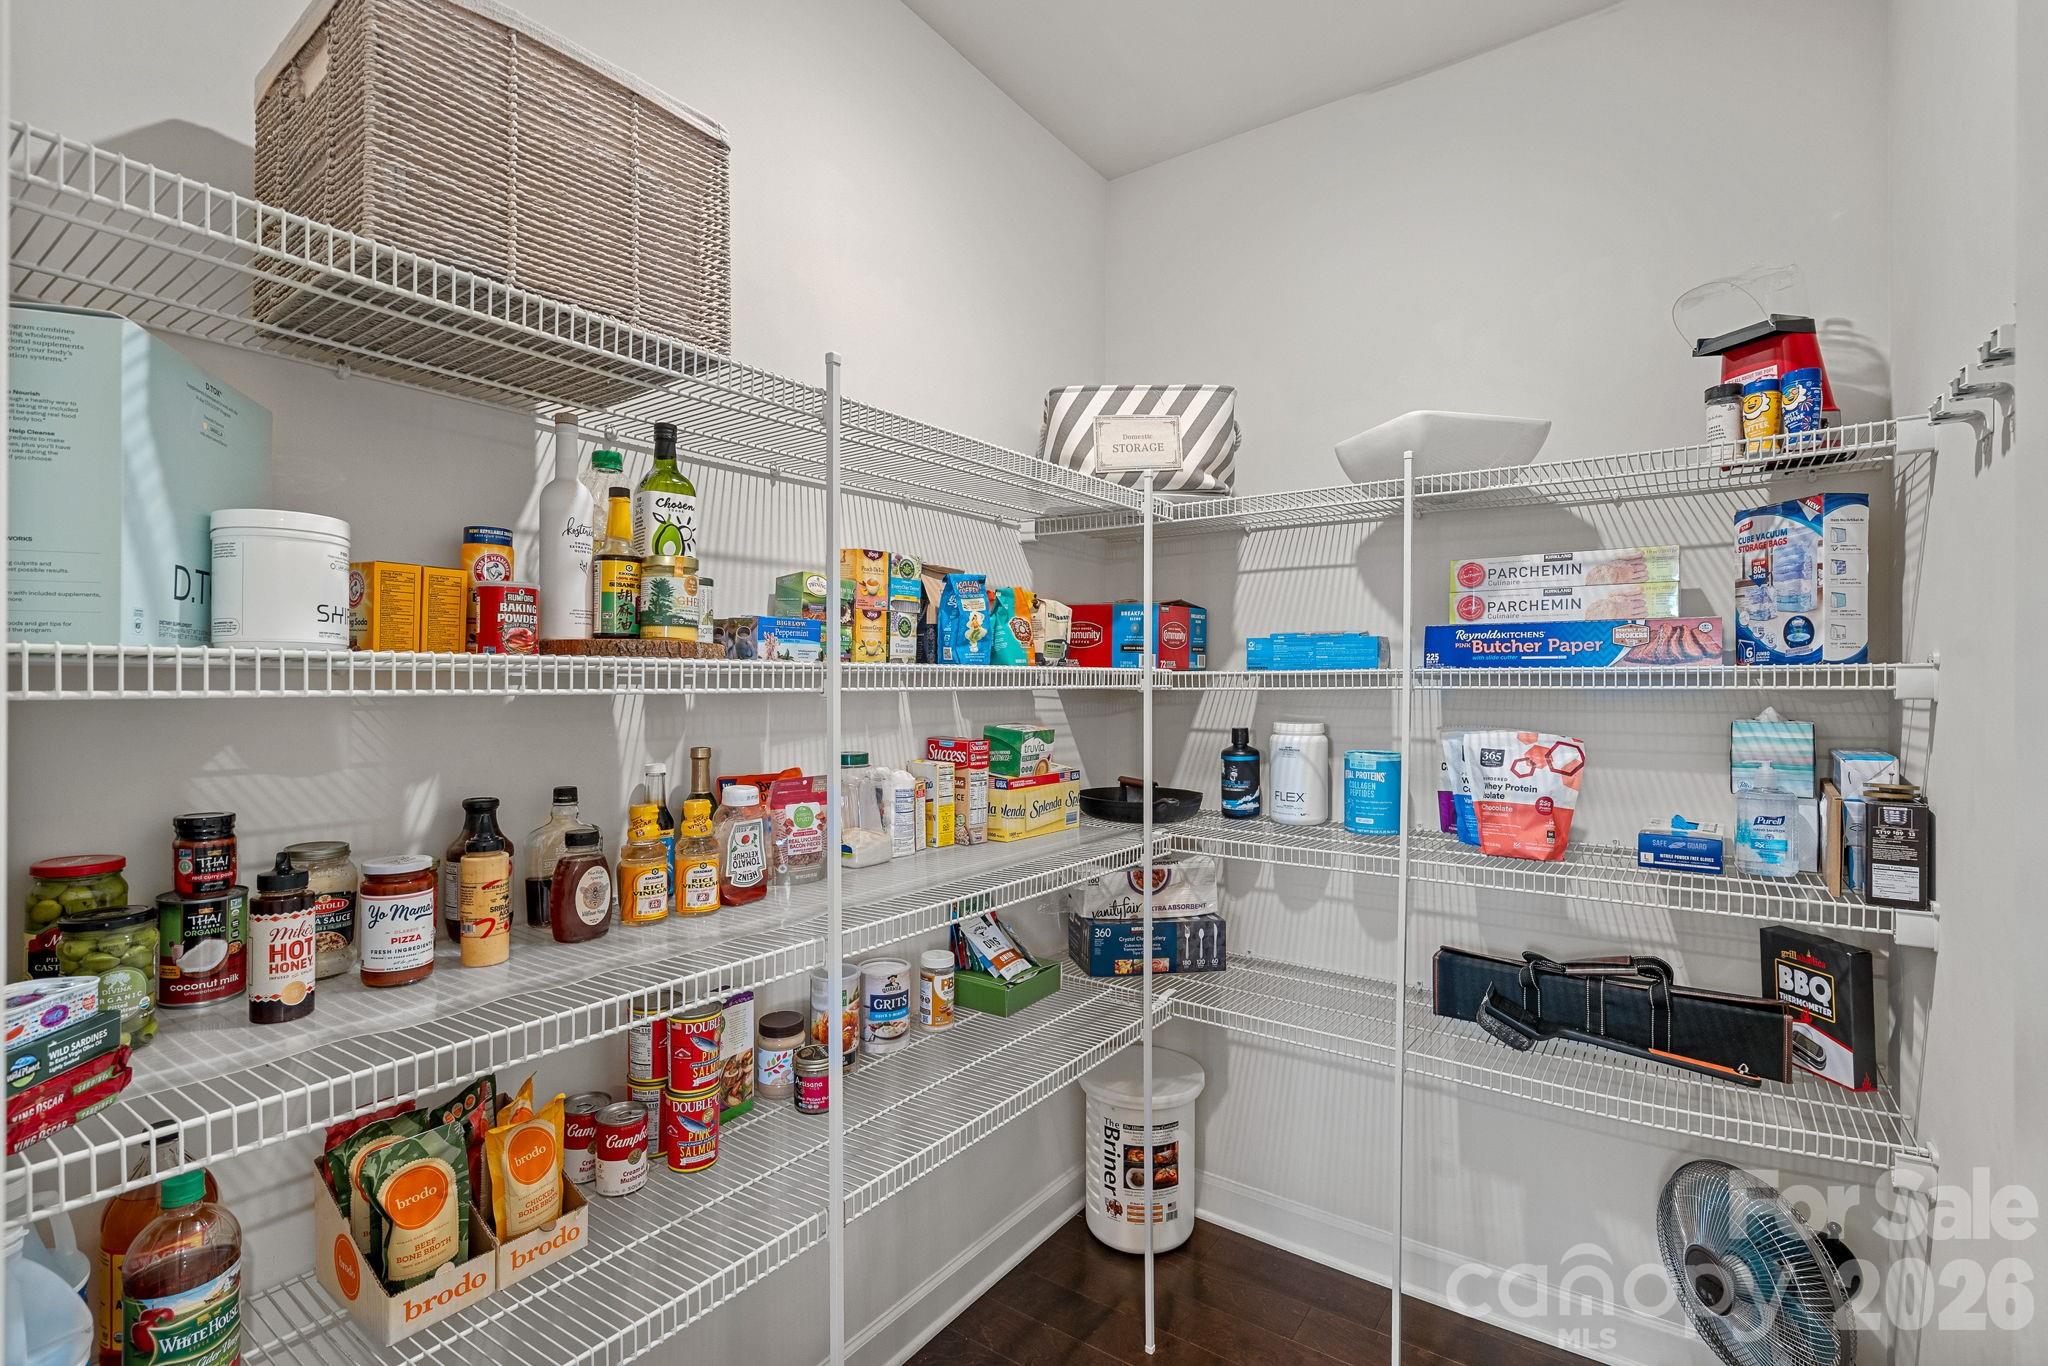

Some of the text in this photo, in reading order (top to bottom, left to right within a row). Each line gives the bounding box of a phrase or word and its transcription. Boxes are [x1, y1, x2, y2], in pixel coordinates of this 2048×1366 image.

[36, 325, 75, 335] combines
[24, 331, 72, 343] wholesome,
[26, 346, 73, 357] your body's
[32, 340, 85, 350] supplements
[13, 389, 41, 397] Nourish
[16, 402, 37, 411] taking
[26, 428, 55, 437] Cleanse
[1112, 442, 1165, 453] STORAGE
[655, 496, 696, 511] Chosen
[1805, 499, 1821, 512] NEW
[1738, 528, 1788, 545] CUBE VACUUM
[1737, 536, 1788, 554] STORAGE BAGS
[1544, 553, 1573, 561] KIRKLAND
[491, 553, 511, 577] HAMMER
[1488, 563, 1583, 580] PARCHEMIN
[609, 581, 636, 590] SESAME
[1488, 579, 1521, 587] Culinaire
[507, 594, 534, 602] RUMFORD
[500, 602, 537, 614] BAKING
[1487, 598, 1582, 613] PARCHEMIN
[497, 613, 538, 625] POWDER
[775, 627, 809, 639] Peppermint
[1163, 629, 1186, 642] Community
[1455, 629, 1545, 640] Reynolds KITCHENS
[1471, 640, 1543, 654] Butcher
[1547, 638, 1604, 656] Paper
[1745, 647, 1754, 659] 6
[1426, 653, 1440, 661] 225
[1160, 660, 1167, 669] 72
[929, 743, 967, 764] Success
[970, 743, 989, 752] Success
[1024, 742, 1046, 754] truvia
[1481, 750, 1502, 762] 365
[1071, 772, 1080, 780] USA
[1356, 770, 1386, 783] PROTEINS
[995, 781, 1007, 789] USA
[1349, 779, 1376, 791] COLLAGEN
[1505, 783, 1538, 794] Protein
[1274, 792, 1305, 803] FLEX
[1350, 788, 1375, 798] PEPTIDES
[1030, 795, 1062, 819] Splenda
[1482, 803, 1513, 813] Chocolate
[1756, 816, 1783, 826] Purell
[789, 842, 806, 850] BACON
[1652, 839, 1708, 850] SAFE GUARD
[732, 850, 760, 858] KETCHUP
[196, 855, 230, 869] THAI
[732, 857, 761, 869] TOMATO
[220, 871, 234, 879] paste
[737, 870, 759, 882] HEINZ
[643, 883, 665, 891] RICE
[1092, 896, 1144, 920] vanity fair
[1167, 902, 1207, 911] ABSORBENT
[187, 913, 222, 926] THAI
[323, 912, 351, 925] SAUCE
[368, 904, 389, 930] Yo
[184, 926, 227, 938] ORGANIC
[269, 920, 314, 943] Mike's
[1094, 927, 1112, 938] 360
[390, 933, 422, 945] PIZZA
[268, 937, 313, 964] HOT
[268, 956, 313, 975] HONEY
[170, 973, 240, 992] coconut milk
[1778, 963, 1832, 1008] BBQ
[101, 984, 133, 996] DIVINA
[107, 1002, 129, 1011] Pitted
[873, 994, 908, 1011] GRITS
[1778, 991, 1833, 1018] THERMOMETER
[684, 1017, 721, 1036] DOUBLE
[48, 1028, 109, 1061] WILD SARDINES
[55, 1043, 96, 1066] Extra Virgin Olive
[20, 1061, 41, 1076] Planet
[48, 1064, 63, 1074] Lightly
[77, 1072, 111, 1094] SARDINES
[795, 1076, 823, 1090] Artisana
[35, 1093, 65, 1115] OSCAR
[672, 1099, 712, 1114] DOUBLE
[1103, 1116, 1120, 1129] The
[688, 1129, 711, 1142] PINK
[679, 1140, 716, 1158] SALMON
[513, 1144, 547, 1168] brodo
[1103, 1125, 1121, 1197] Briner
[620, 1169, 648, 1185] Mushroom
[622, 1167, 641, 1178] Cream
[395, 1184, 438, 1211] brodo
[525, 1186, 556, 1209] CHICKEN
[518, 1204, 540, 1219] BONE
[395, 1235, 452, 1264] BONE BROTH
[414, 1236, 437, 1252] BEEF
[510, 1225, 582, 1272] brodo
[402, 1271, 488, 1324] brodo
[158, 1302, 240, 1355] WHITE HOUSE
